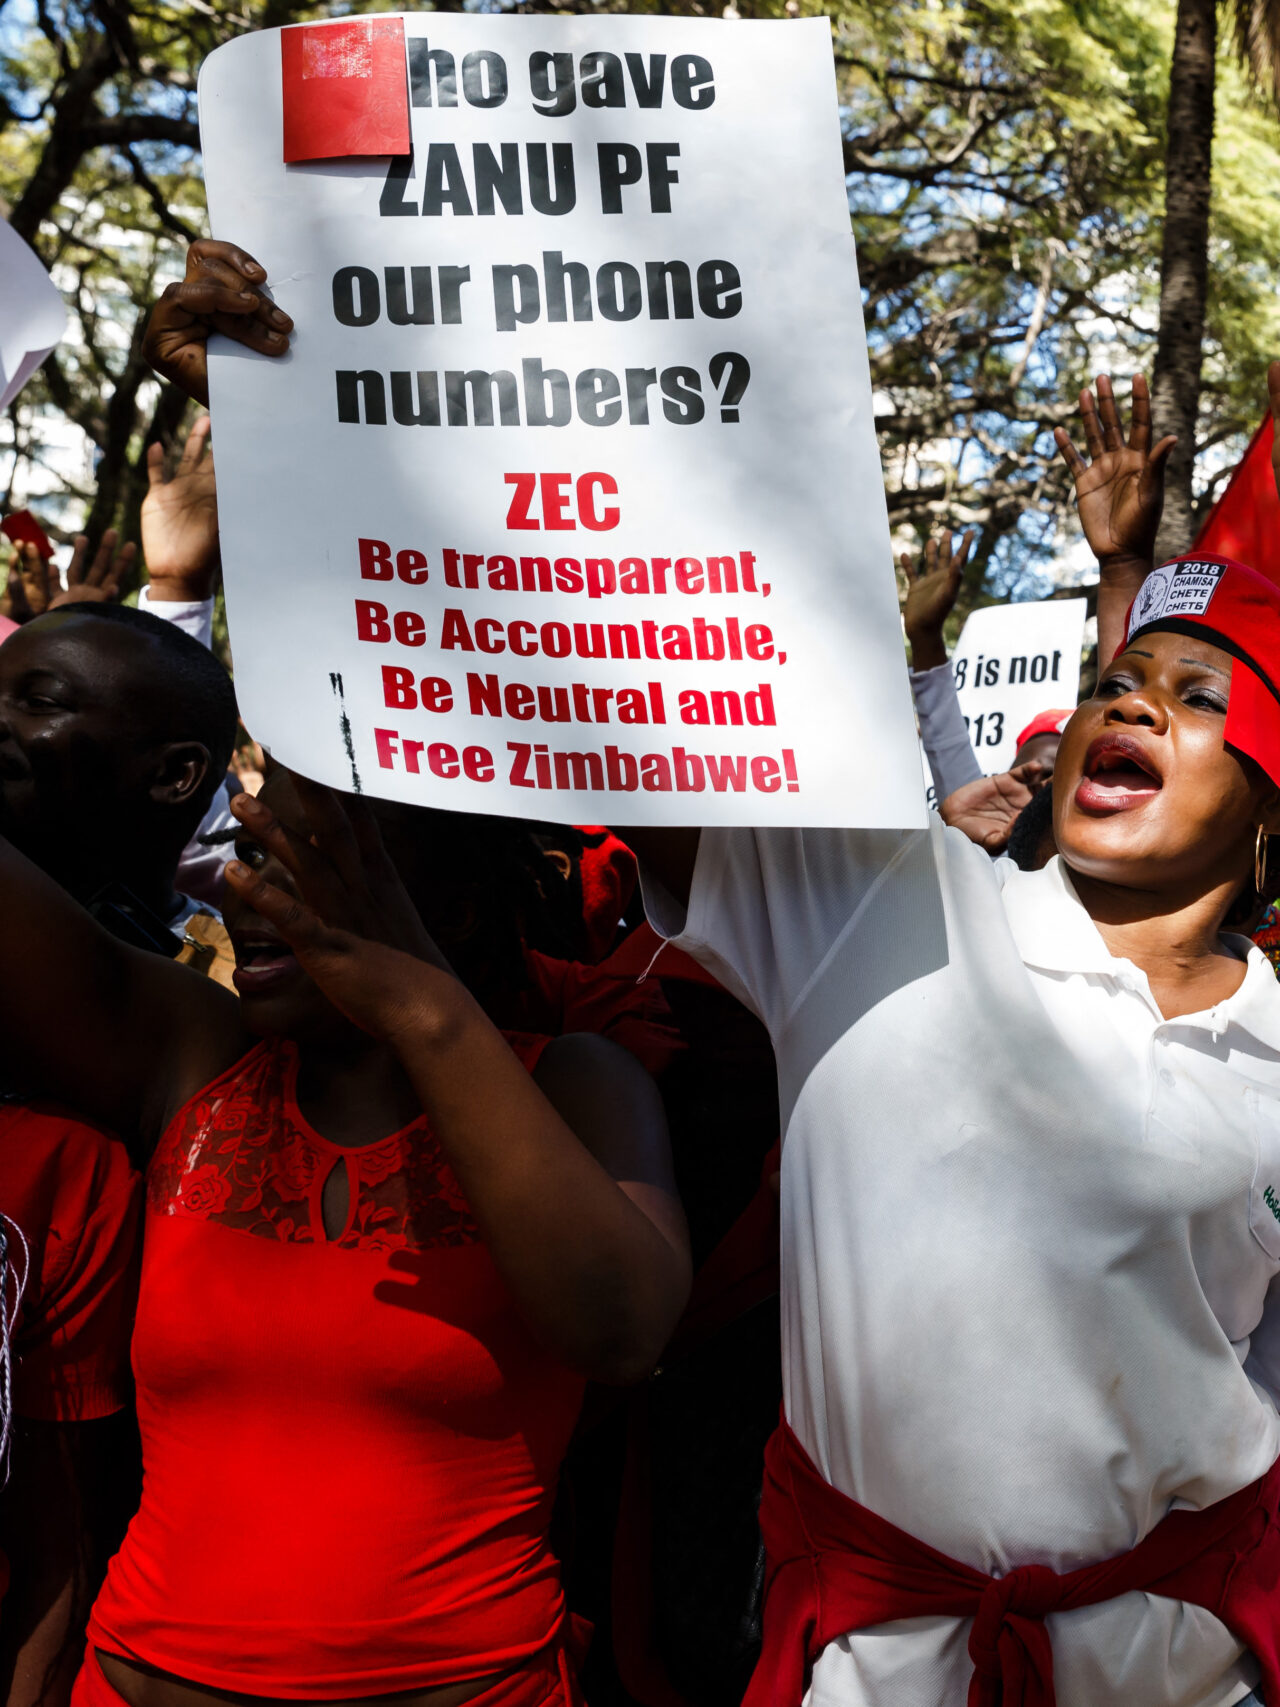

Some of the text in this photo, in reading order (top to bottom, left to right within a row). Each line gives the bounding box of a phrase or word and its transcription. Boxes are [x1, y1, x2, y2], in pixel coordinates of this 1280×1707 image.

[408, 37, 716, 117] ho gave
[379, 142, 681, 217] ZANU PF
[331, 250, 743, 332] our phone
[336, 351, 751, 428] numbers?
[504, 471, 621, 532] ZEC
[357, 538, 772, 599] Be transparent,
[1169, 589, 1209, 600] CHETE
[1173, 576, 1214, 588] CHAMISA
[1181, 563, 1220, 575] 2018
[354, 599, 788, 665] Be Accountable,
[381, 665, 778, 727] Be Neutral and
[974, 654, 1000, 688] is
[1008, 650, 1062, 684] not
[964, 711, 1004, 747] 13
[374, 728, 801, 793] Free Zimbabwe!
